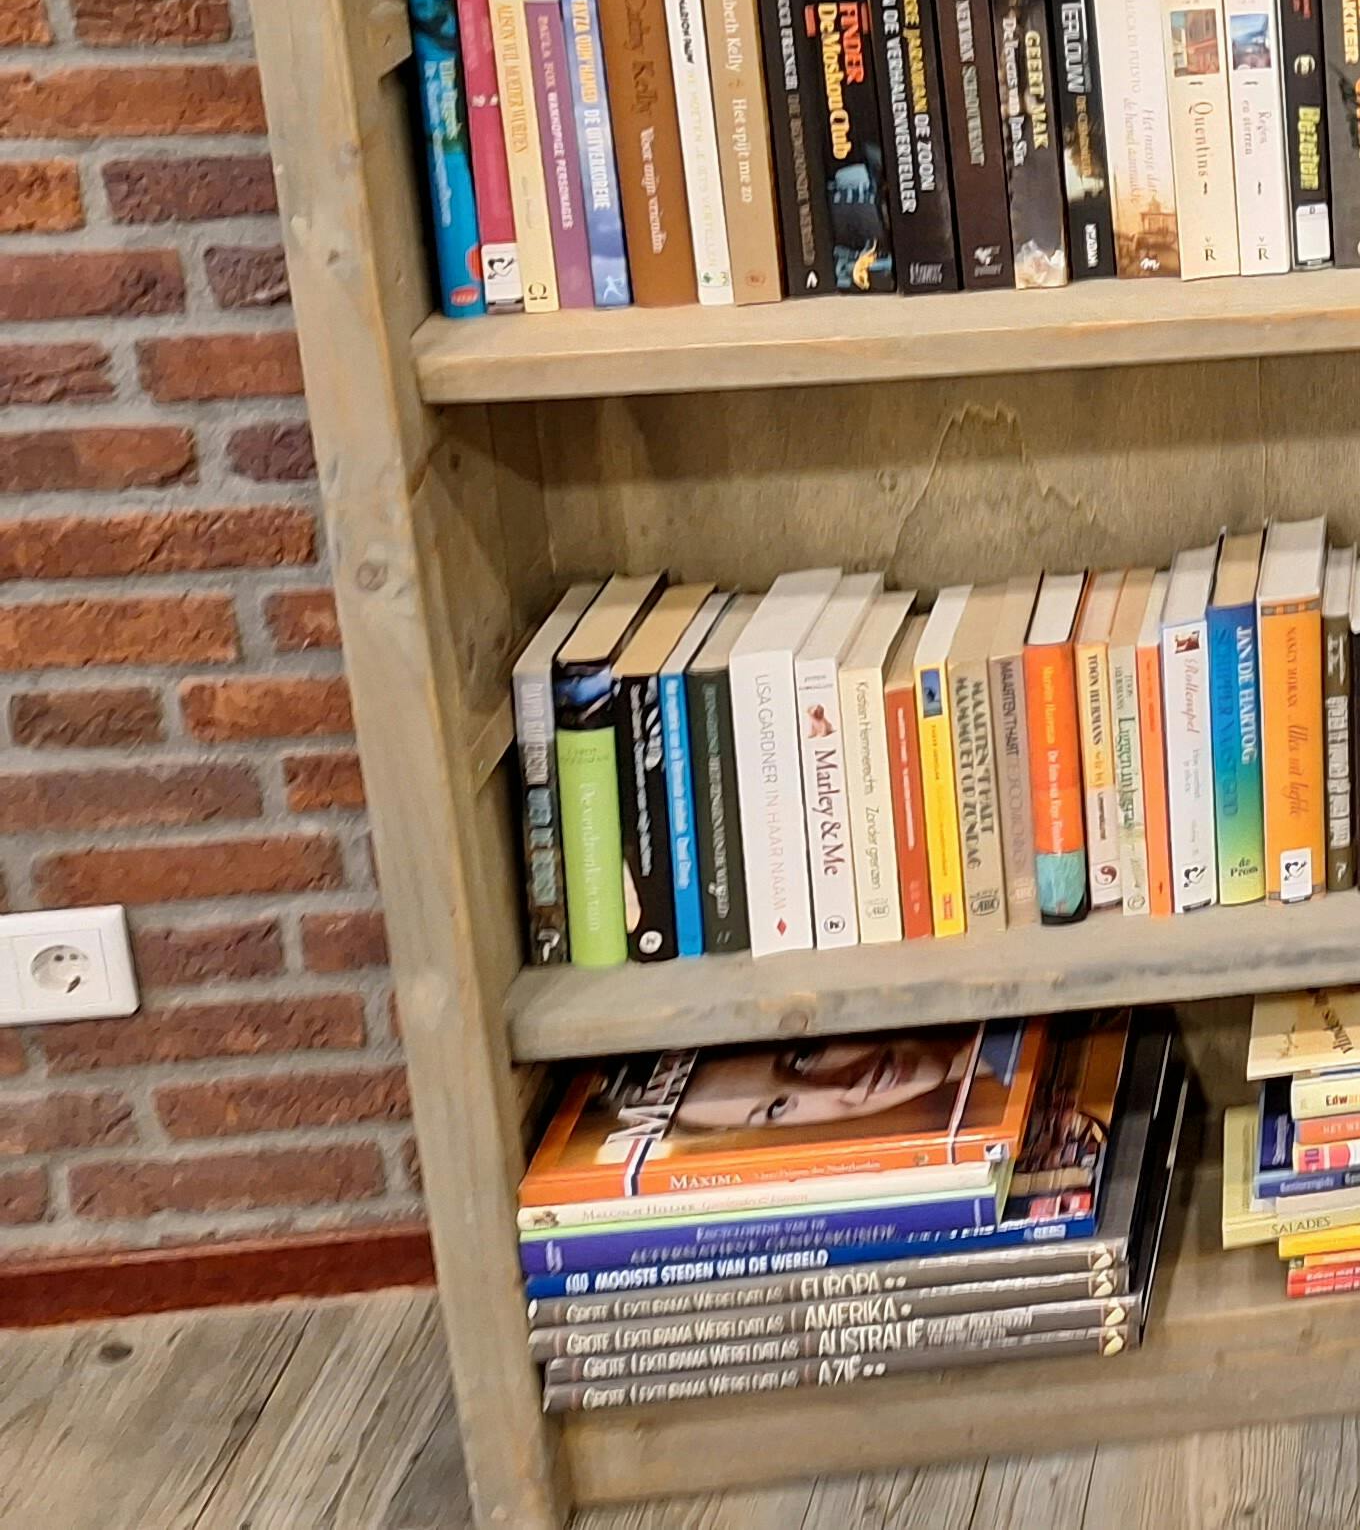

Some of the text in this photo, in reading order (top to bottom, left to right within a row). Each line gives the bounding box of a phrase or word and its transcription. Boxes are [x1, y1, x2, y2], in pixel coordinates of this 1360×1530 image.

[724, 37, 744, 72] Kelly
[732, 98, 748, 124] Het
[1025, 30, 1048, 150] GEERT MAK
[584, 109, 600, 125] DE
[829, 112, 852, 160] Club
[1189, 101, 1214, 177] Quentins
[733, 127, 751, 158] spijt
[913, 114, 935, 191] DE ZOON
[739, 161, 751, 184] me
[741, 186, 752, 203] zo
[1000, 661, 1016, 717] MAARTEN
[1088, 653, 1103, 745] TOON HERMANS
[1181, 658, 1199, 734] Rollenspel
[1236, 626, 1257, 764] JAN DE HARTOG
[971, 681, 989, 767] MAARTEN
[755, 674, 787, 911] LISA GARDNER IN HAAR NAAM
[955, 676, 982, 870] MAMMOET ZONDAG
[812, 750, 844, 876] Marley & Me
[865, 806, 879, 846] Zonder
[1271, 1216, 1331, 1236] SALADES
[566, 1249, 829, 1295] 100 MOOISTE STEDEN VAN DE WERELD
[800, 1271, 879, 1299] EUROPA
[803, 1297, 897, 1330] AMERIKA
